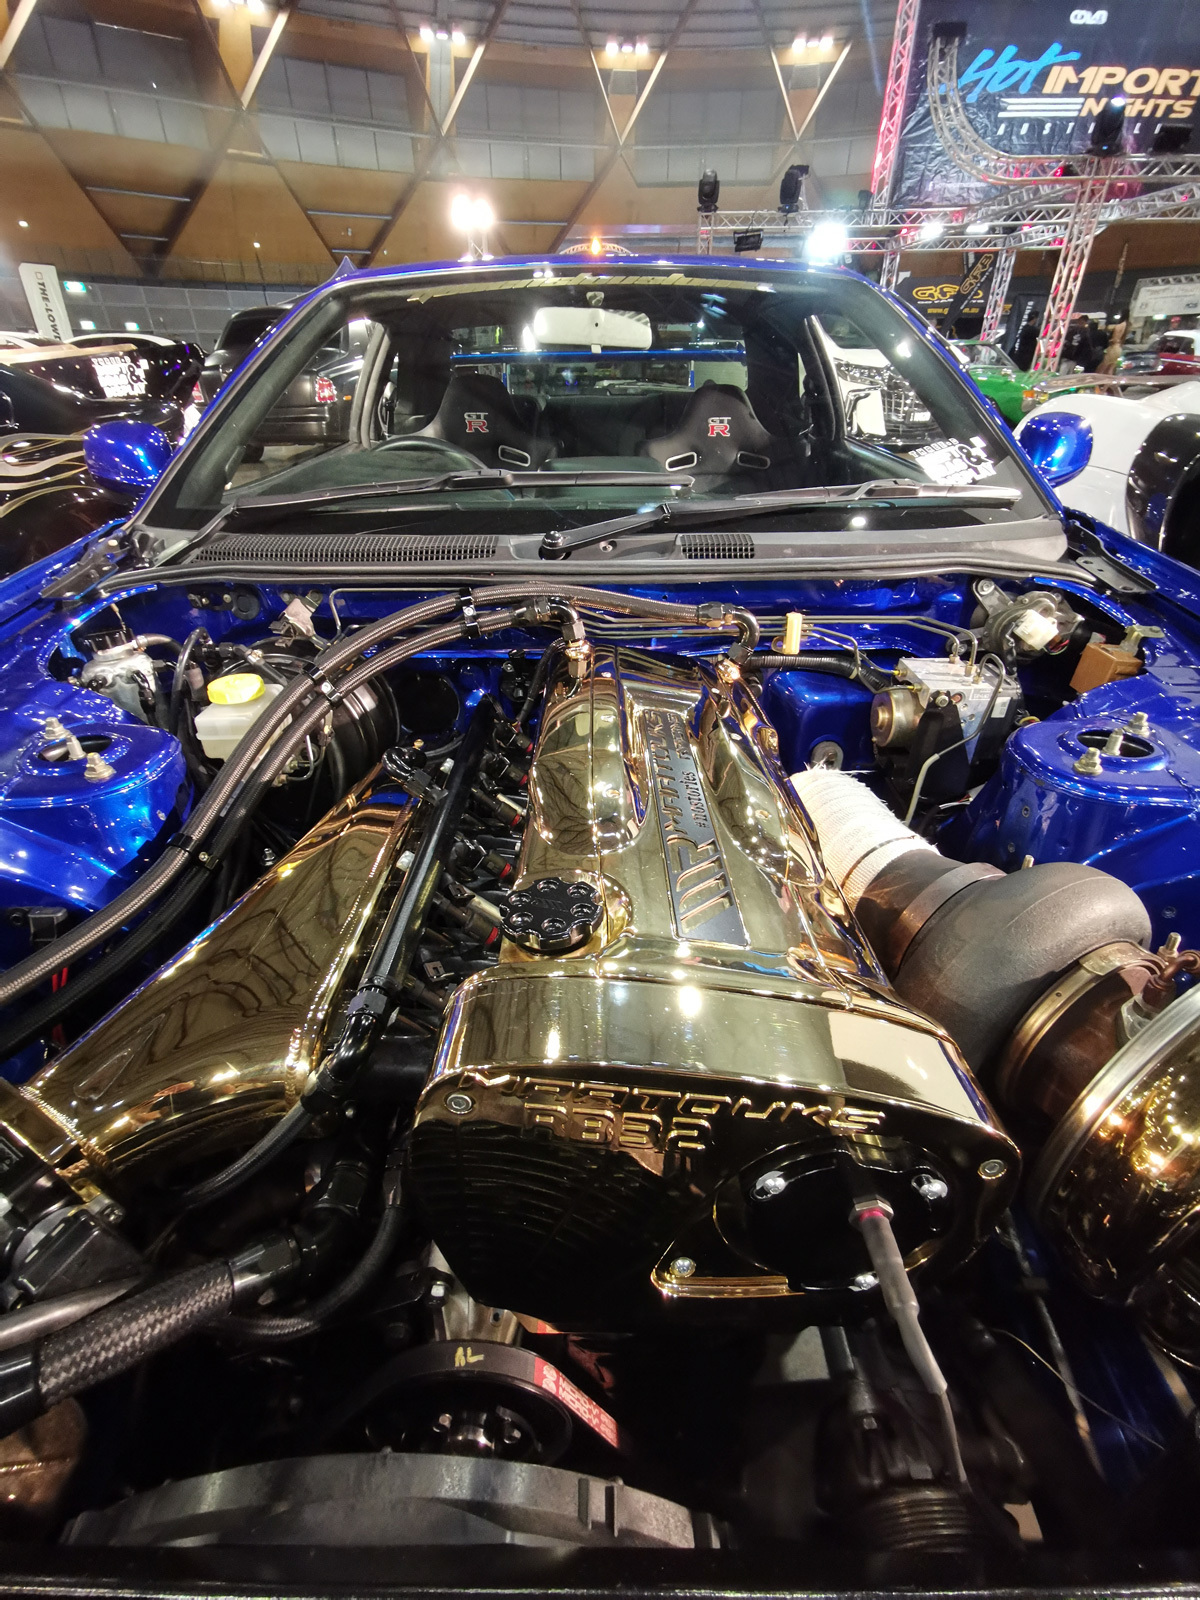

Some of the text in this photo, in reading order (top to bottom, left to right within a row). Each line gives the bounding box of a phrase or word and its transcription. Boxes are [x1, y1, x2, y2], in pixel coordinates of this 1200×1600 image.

[939, 41, 1081, 103] Hot
[1079, 97, 1197, 119] NHTS
[681, 770, 710, 829] #nostories
